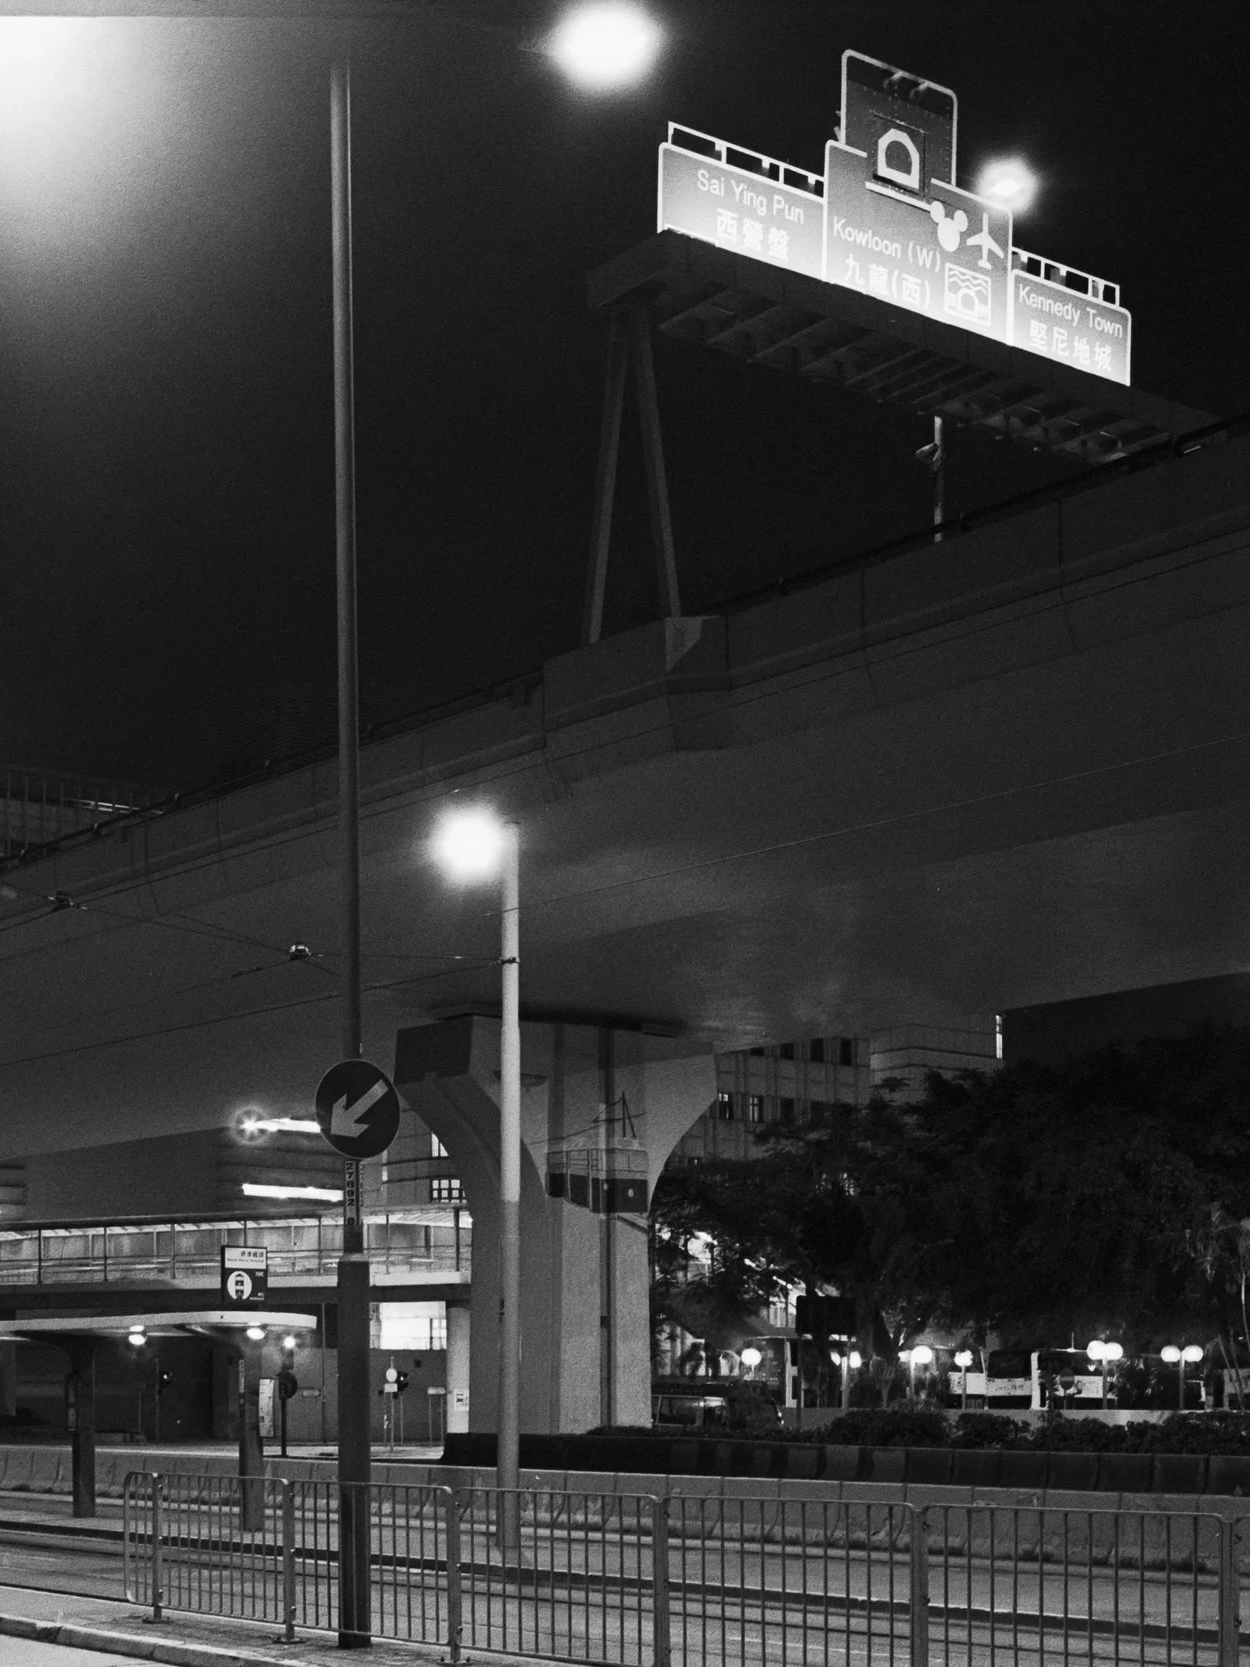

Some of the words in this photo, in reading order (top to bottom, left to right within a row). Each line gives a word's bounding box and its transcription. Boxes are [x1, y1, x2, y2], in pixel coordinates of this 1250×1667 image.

[697, 169, 725, 197] Sai
[730, 179, 767, 216] Ying
[772, 194, 804, 225] Pun
[715, 207, 790, 261] 西營盤
[833, 216, 901, 259] Kowloon
[908, 241, 941, 273] (W)
[1019, 283, 1081, 327] Kennedy
[1086, 307, 1123, 338] Town
[1029, 319, 1112, 373] 堅尼地城
